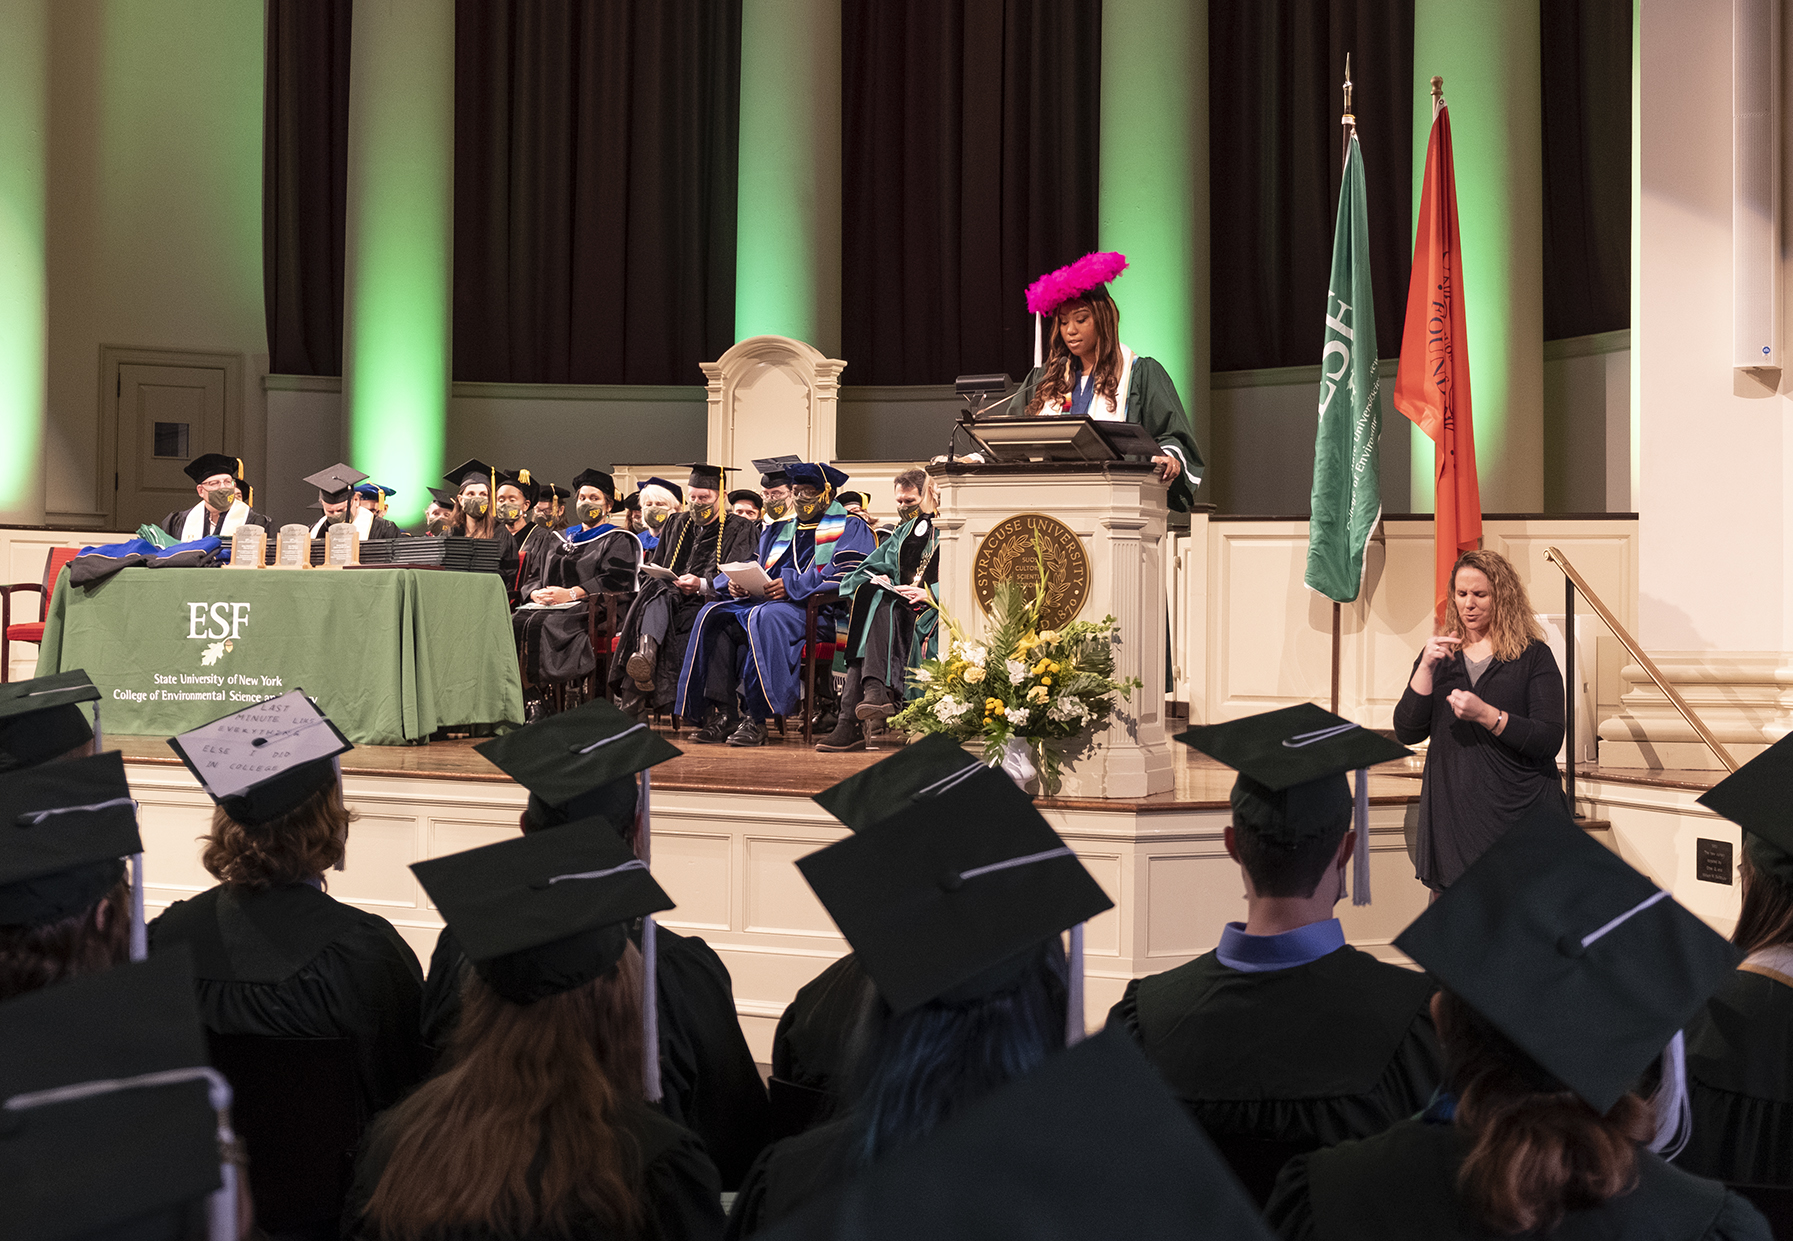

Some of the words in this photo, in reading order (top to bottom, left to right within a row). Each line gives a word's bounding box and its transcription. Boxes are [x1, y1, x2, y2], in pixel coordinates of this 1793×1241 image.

[978, 520, 1022, 587] SYRACUSE
[1028, 518, 1084, 586] UNIVERSITY
[1054, 598, 1077, 623] 1870
[187, 602, 250, 639] ESF
[154, 673, 177, 685] State
[180, 674, 225, 687] University
[227, 674, 239, 685] of
[239, 675, 258, 686] New
[260, 675, 283, 687] York
[113, 689, 147, 703] College
[149, 690, 161, 701] of
[162, 690, 225, 701] Environmental
[229, 691, 262, 703] Science
[264, 692, 283, 702] an
[261, 704, 290, 712] LAST
[235, 714, 280, 723] MINUTE
[202, 745, 229, 755] ELSE
[272, 751, 291, 759] DID
[205, 760, 218, 769] IN
[229, 762, 279, 772] COLLEGE
